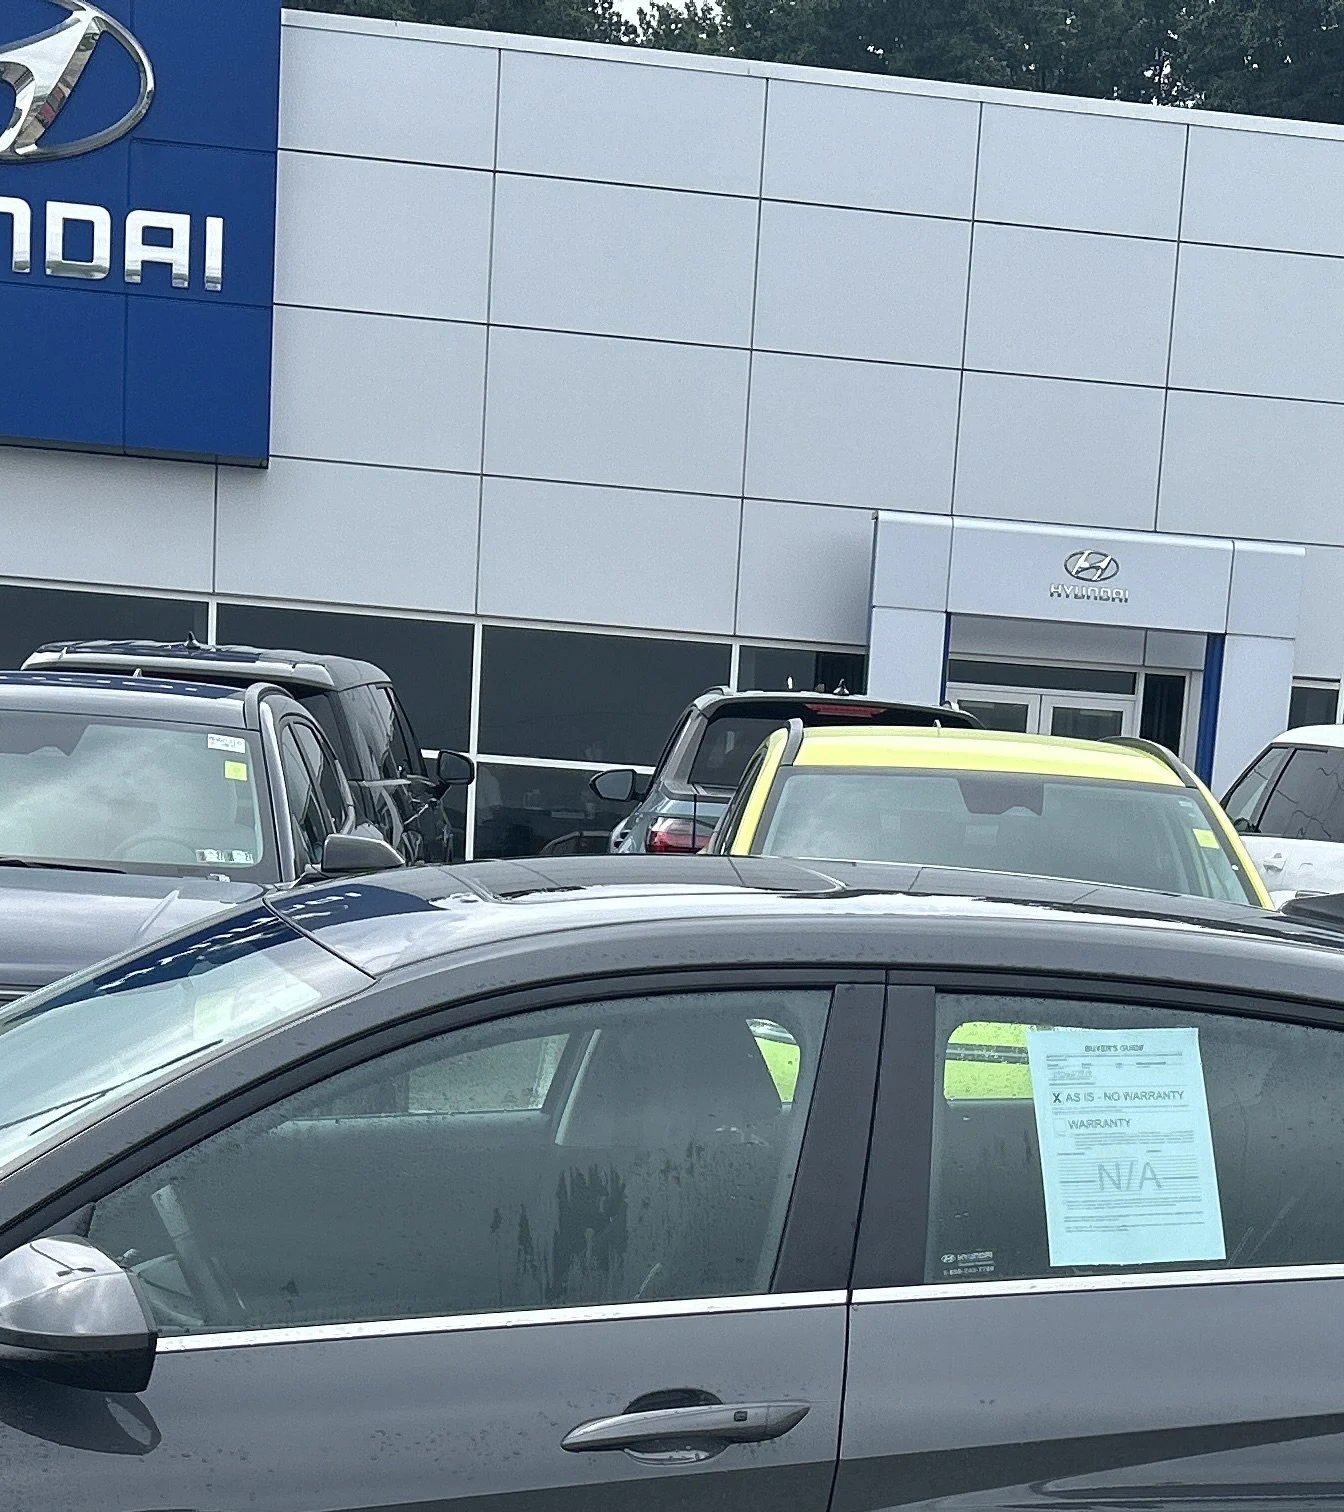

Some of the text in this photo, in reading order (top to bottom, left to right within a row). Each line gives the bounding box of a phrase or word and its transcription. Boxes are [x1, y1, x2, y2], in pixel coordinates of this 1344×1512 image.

[1049, 583, 1129, 603] HYUNDAI
[1052, 1092, 1062, 1104] X
[1065, 1092, 1081, 1102] AS
[1083, 1091, 1095, 1102] IS
[1103, 1091, 1120, 1101] NO
[1122, 1090, 1184, 1101] WARRANTY
[1067, 1118, 1131, 1130] WARRANTY
[1097, 1161, 1162, 1191] N/A
